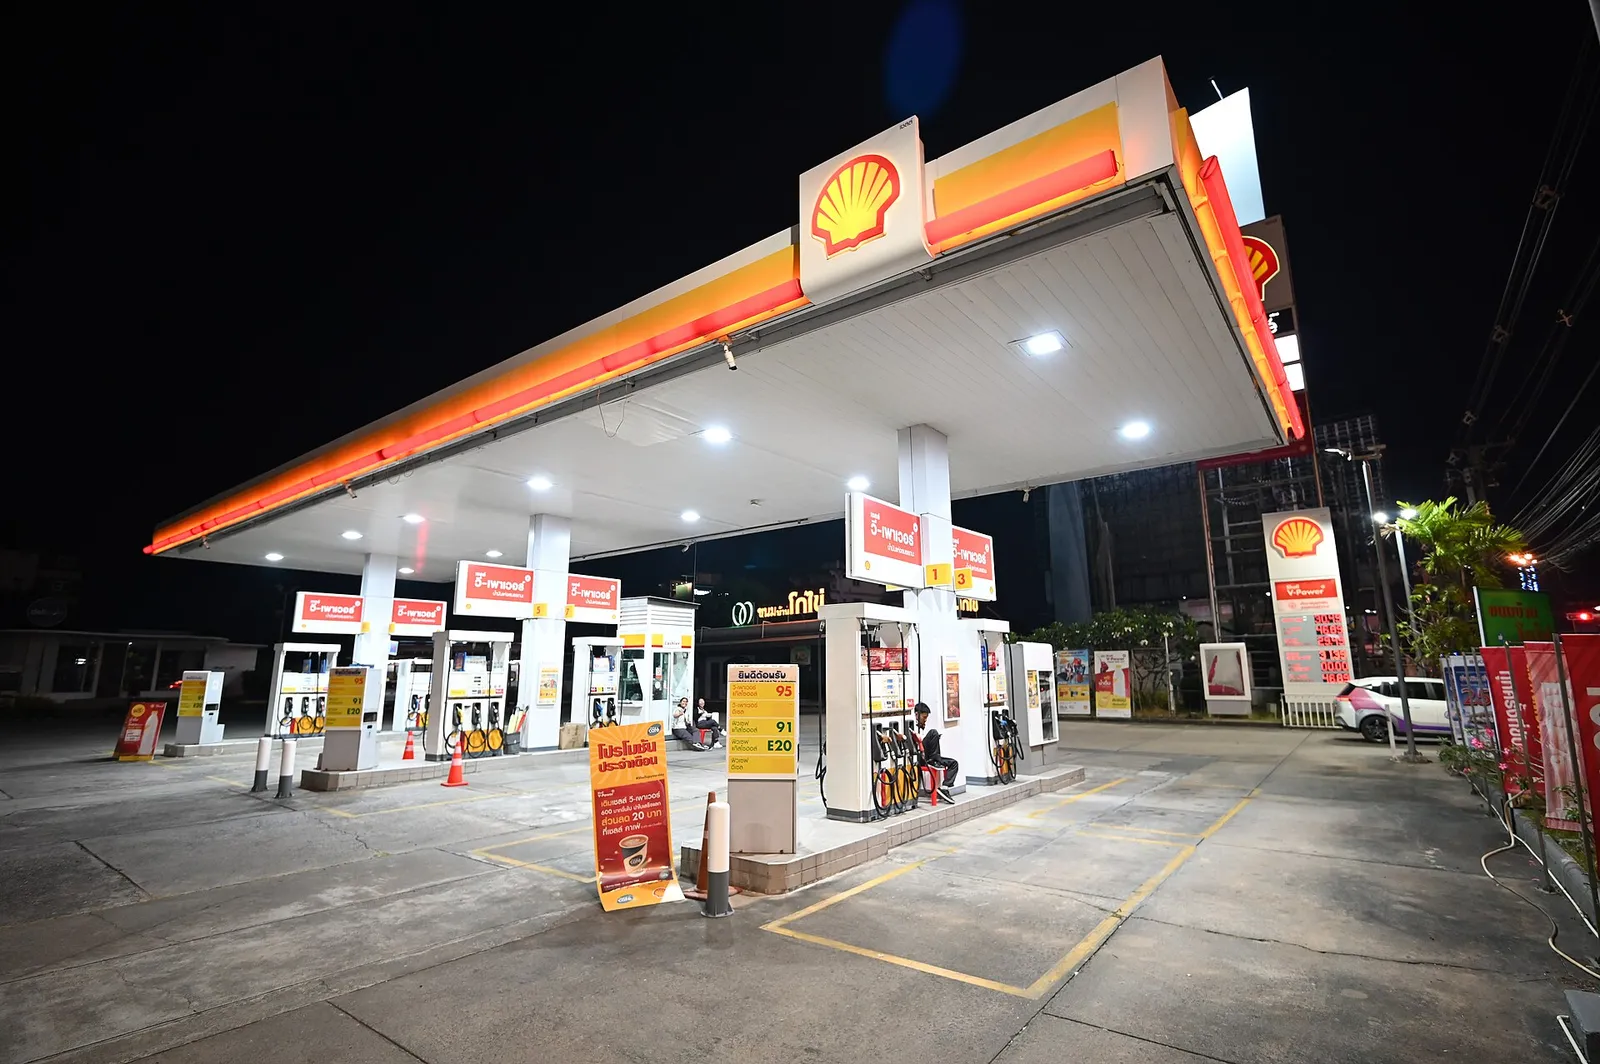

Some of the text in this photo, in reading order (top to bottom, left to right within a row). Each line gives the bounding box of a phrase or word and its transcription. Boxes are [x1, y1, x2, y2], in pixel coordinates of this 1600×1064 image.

[870, 519, 914, 546] วี-เพาเวอร์
[932, 568, 938, 580] 1
[958, 573, 966, 585] 3
[474, 576, 526, 592] วี-เพาเวอร์
[1287, 588, 1324, 596] V-Power
[536, 606, 541, 614] 5
[738, 671, 786, 679] ยินดีต้อนรับ
[776, 685, 792, 697] 95
[776, 722, 792, 733] 91
[767, 740, 792, 751] E20
[598, 756, 658, 772] ประจำเดือน
[601, 815, 630, 826] ส่วนลด
[632, 811, 644, 821] 20
[647, 809, 662, 818] บาท
